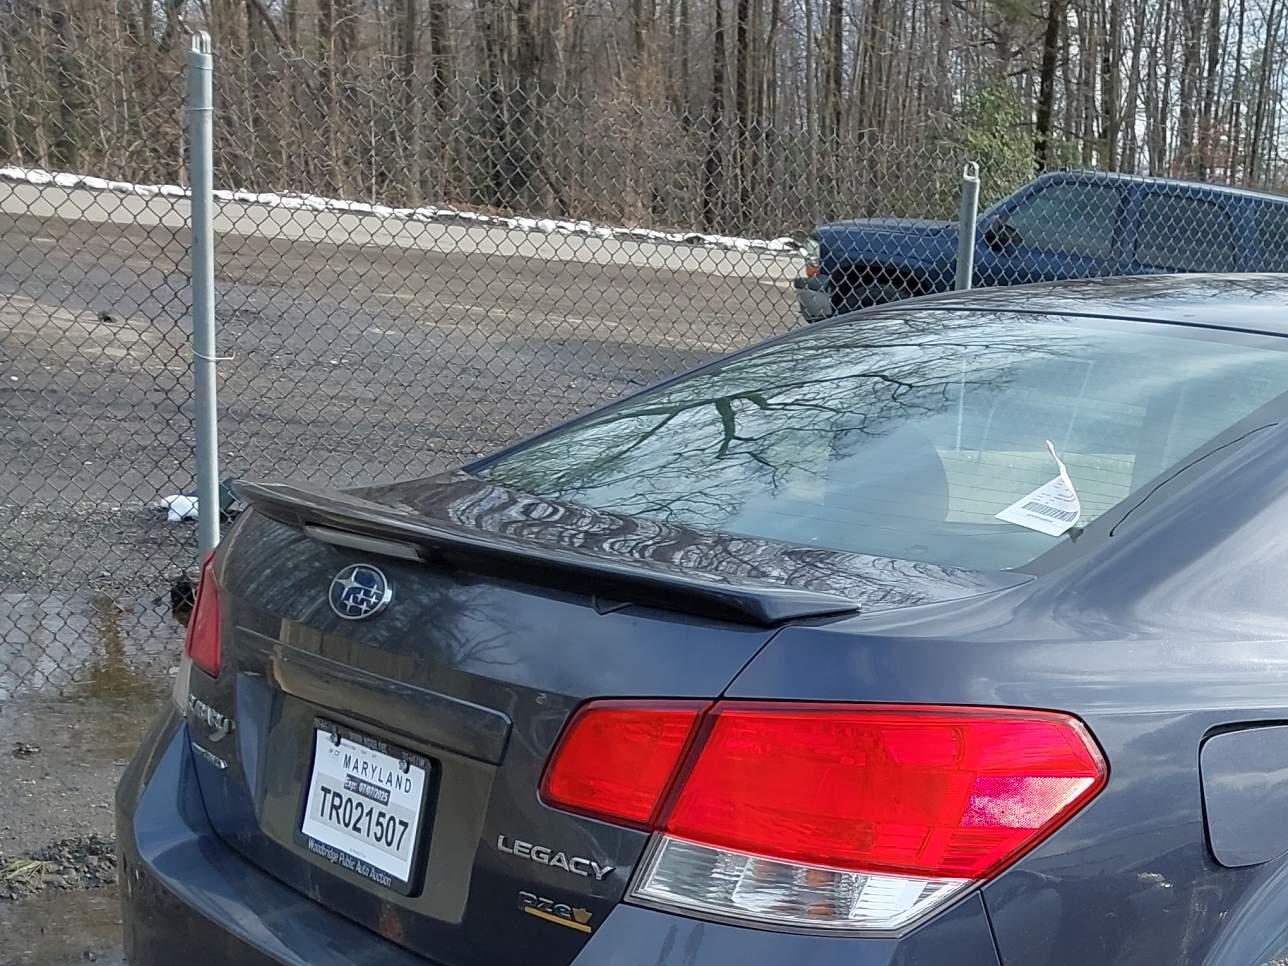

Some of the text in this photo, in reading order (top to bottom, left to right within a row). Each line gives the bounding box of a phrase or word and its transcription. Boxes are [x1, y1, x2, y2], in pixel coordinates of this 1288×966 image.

[343, 753, 412, 794] MARYLAND
[319, 785, 409, 852] TR021507
[339, 852, 355, 871] Public
[355, 860, 370, 877] Auto
[369, 867, 392, 888] Auction
[497, 834, 617, 882] LEGACY
